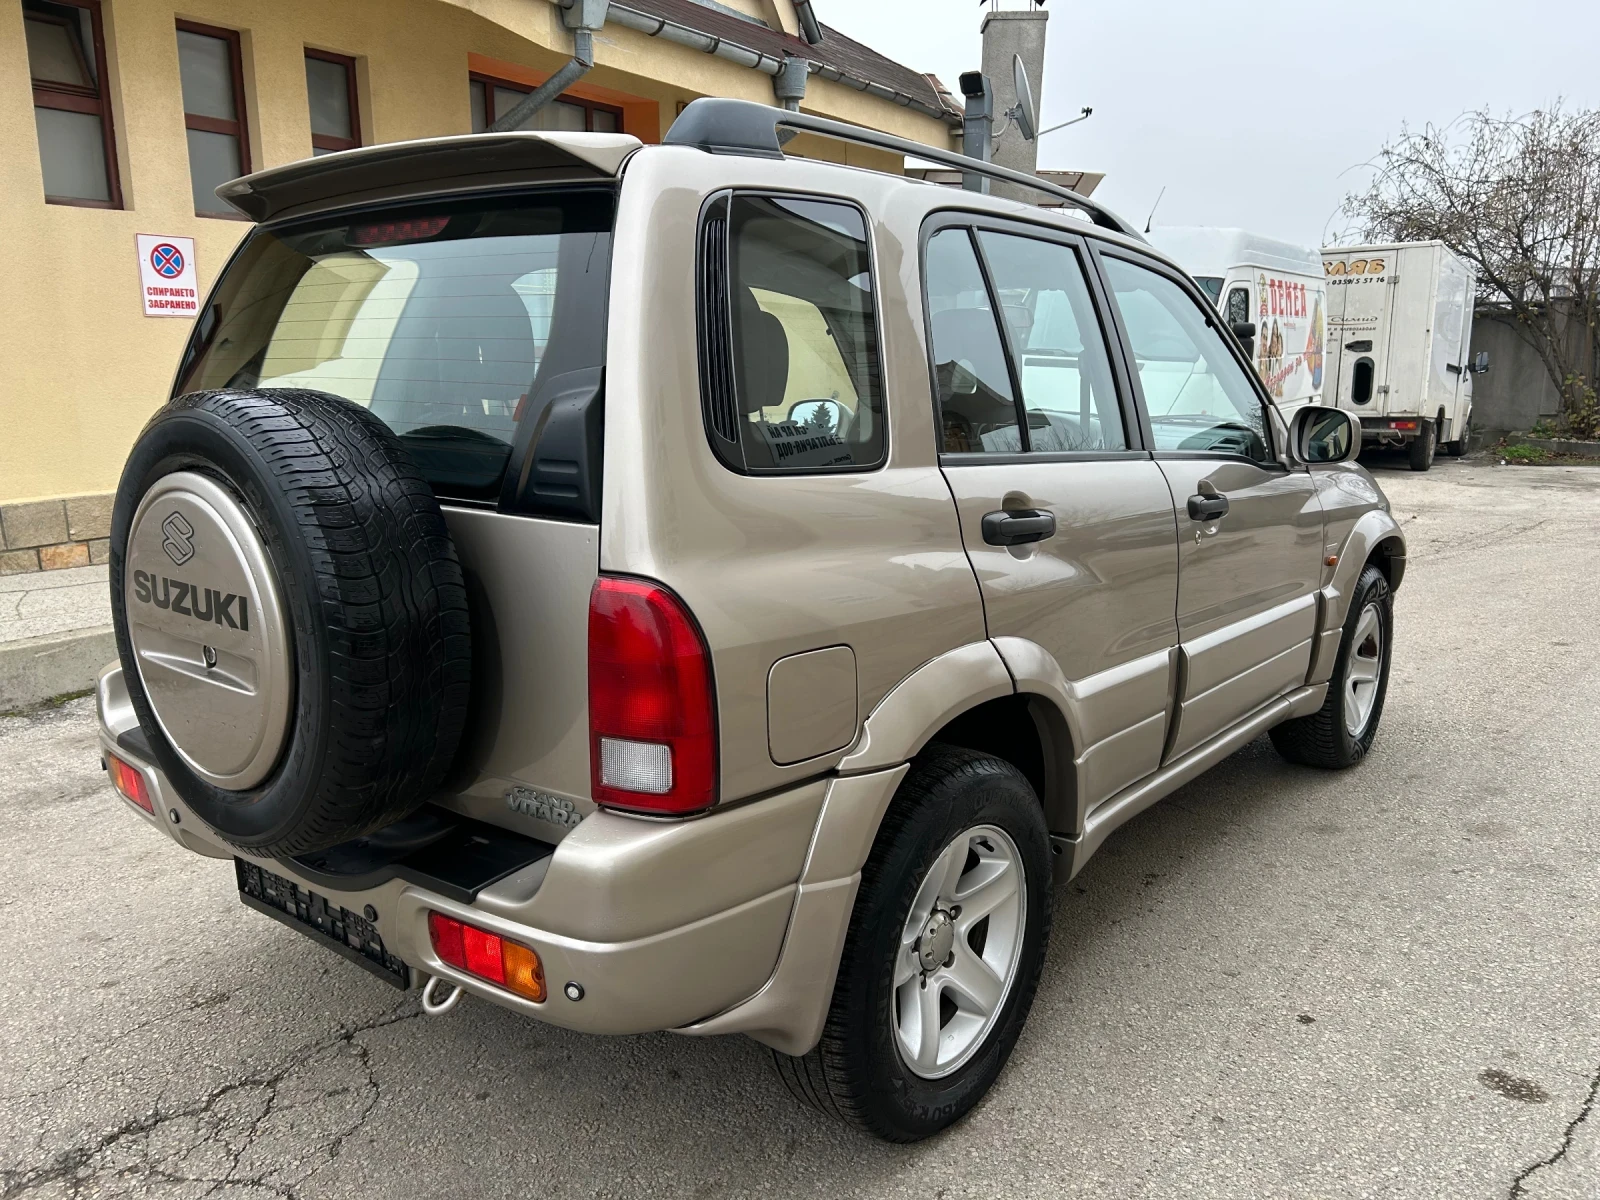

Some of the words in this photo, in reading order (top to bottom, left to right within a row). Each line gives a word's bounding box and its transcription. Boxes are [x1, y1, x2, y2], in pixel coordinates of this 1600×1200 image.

[146, 286, 195, 297] СПИРАНЕТО
[148, 299, 196, 309] ЗАБРАНЕНО
[133, 569, 249, 632] SUZUKI
[505, 793, 583, 828] VITARA
[512, 786, 575, 812] GRAND
